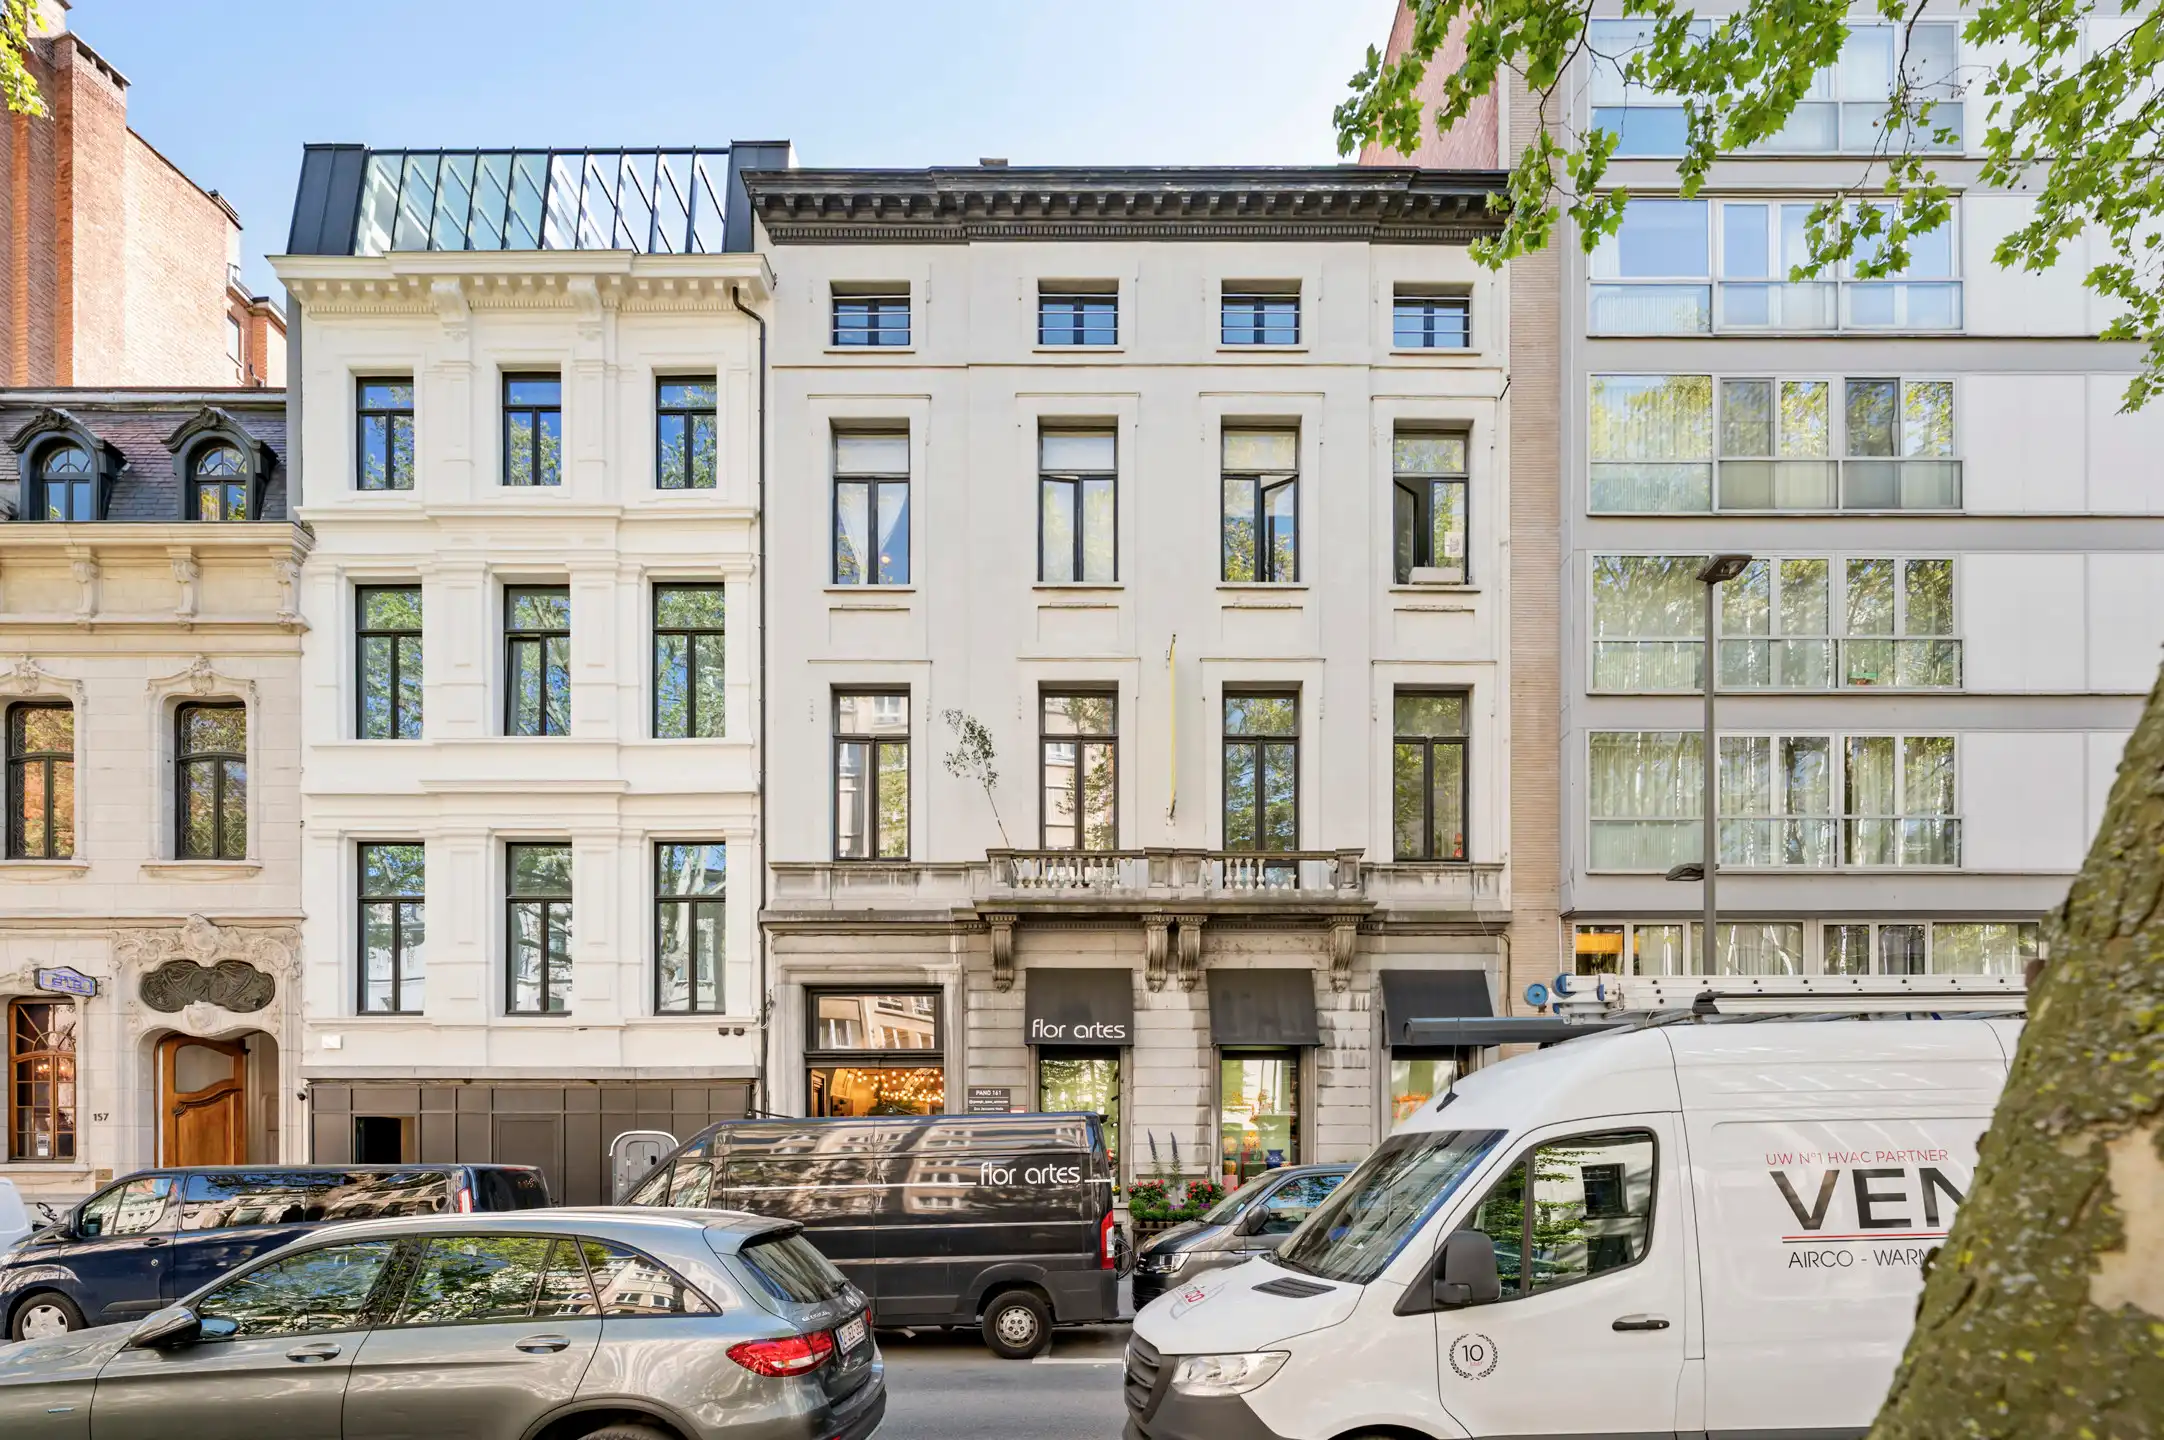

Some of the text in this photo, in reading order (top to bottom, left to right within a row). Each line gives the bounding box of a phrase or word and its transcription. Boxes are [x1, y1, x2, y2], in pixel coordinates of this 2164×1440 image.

[1032, 1018, 1125, 1039] flor artes
[93, 1112, 109, 1121] 157
[1766, 1153, 1793, 1165] UW
[1828, 1151, 1871, 1164] HVAC
[1876, 1149, 1949, 1162] PARTNER
[980, 1161, 1080, 1185] flor artes
[1788, 1250, 1853, 1268] AIRCO
[1461, 1344, 1484, 1362] 10
